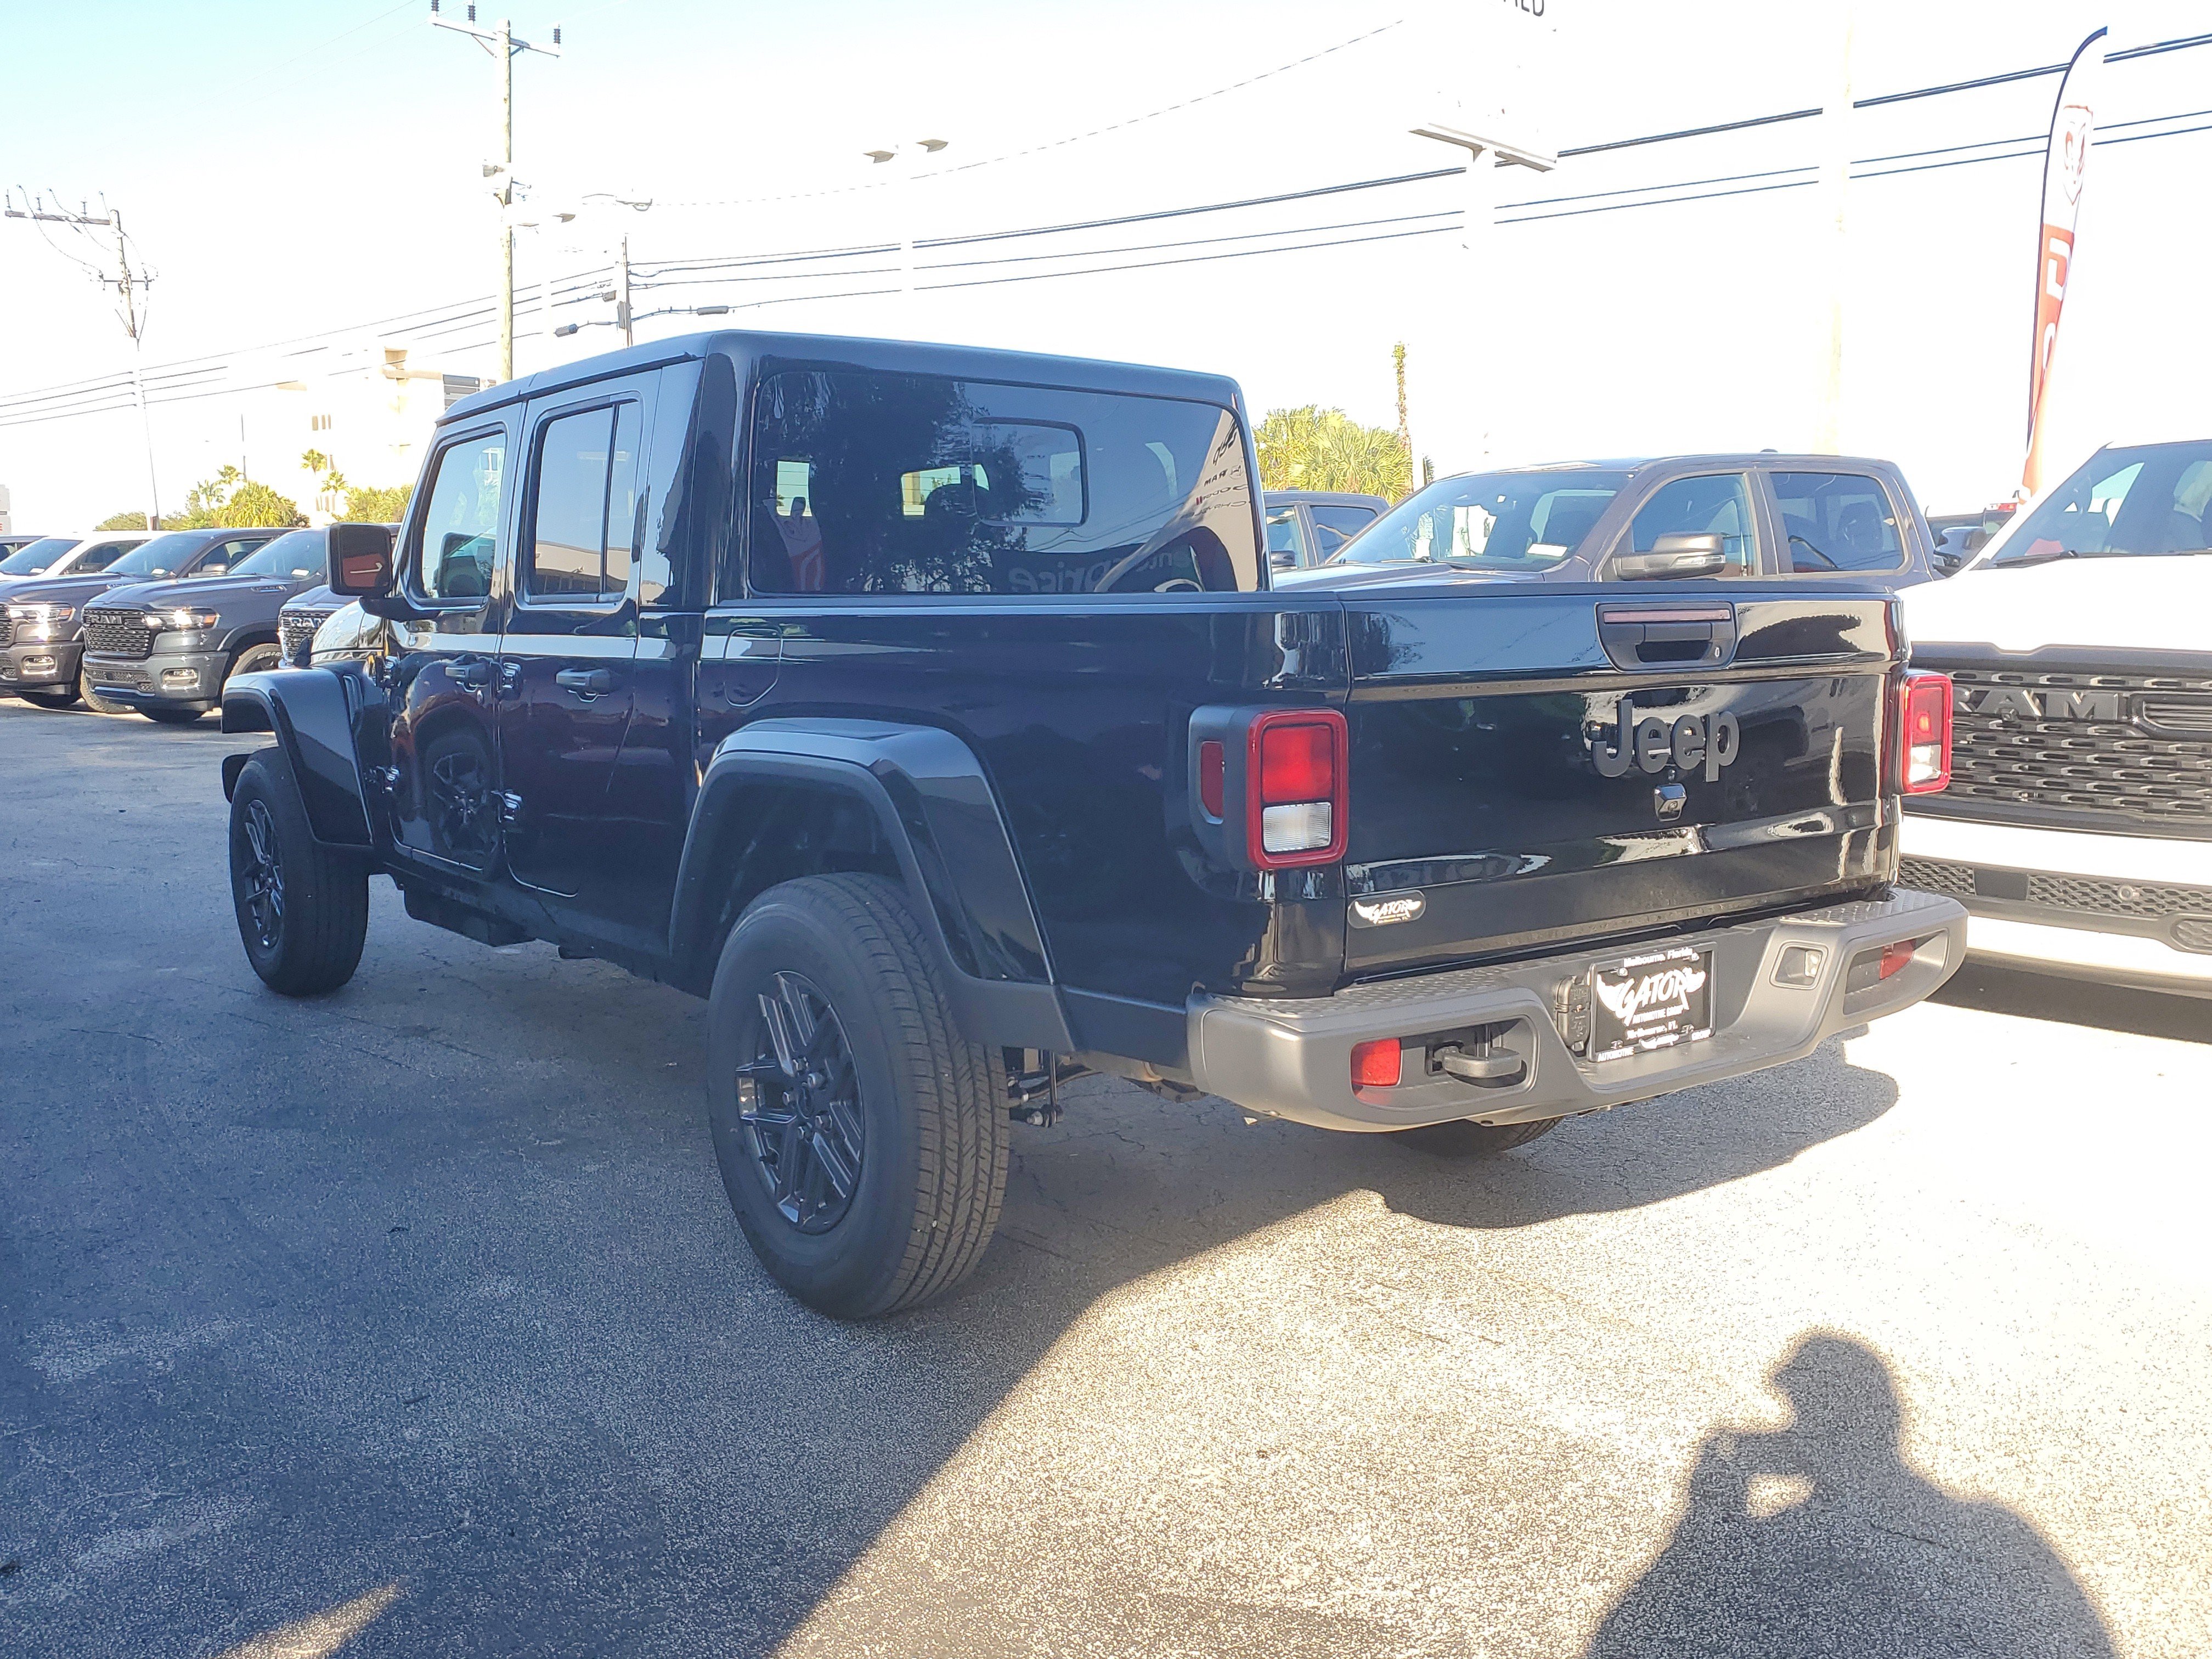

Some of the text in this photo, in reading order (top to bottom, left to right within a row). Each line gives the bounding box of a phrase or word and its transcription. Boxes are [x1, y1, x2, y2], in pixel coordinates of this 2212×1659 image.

[91, 614, 122, 624] RAM
[1592, 698, 1740, 782] Jeep
[1369, 900, 1411, 925] GATOR
[1615, 969, 1690, 1026] GATOR
